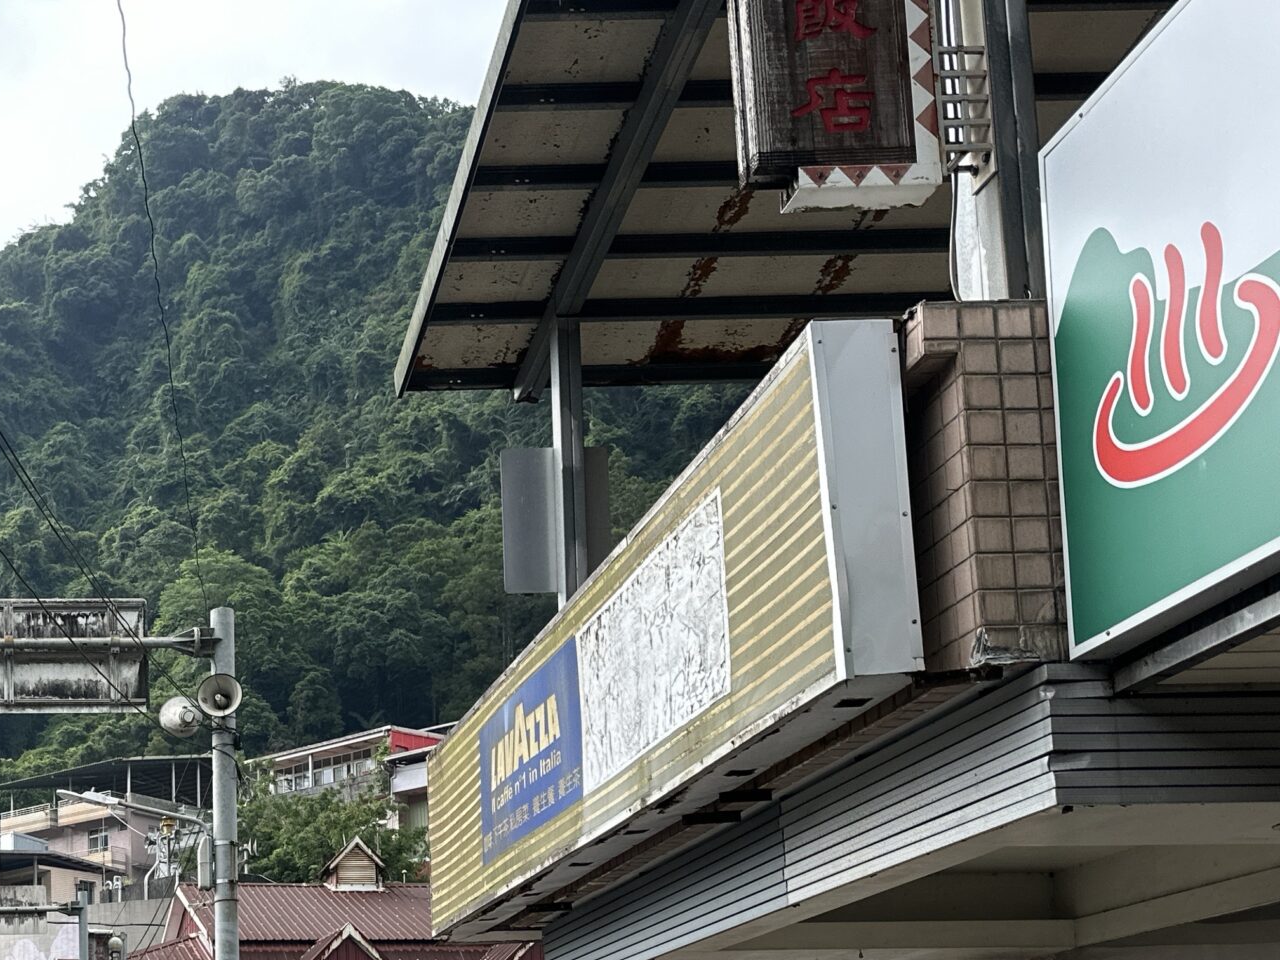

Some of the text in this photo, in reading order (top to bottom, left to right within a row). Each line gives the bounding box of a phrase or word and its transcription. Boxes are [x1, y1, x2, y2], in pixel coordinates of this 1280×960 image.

[491, 693, 561, 792] LAVAZZA
[528, 767, 538, 785] in
[539, 749, 562, 777] Italia
